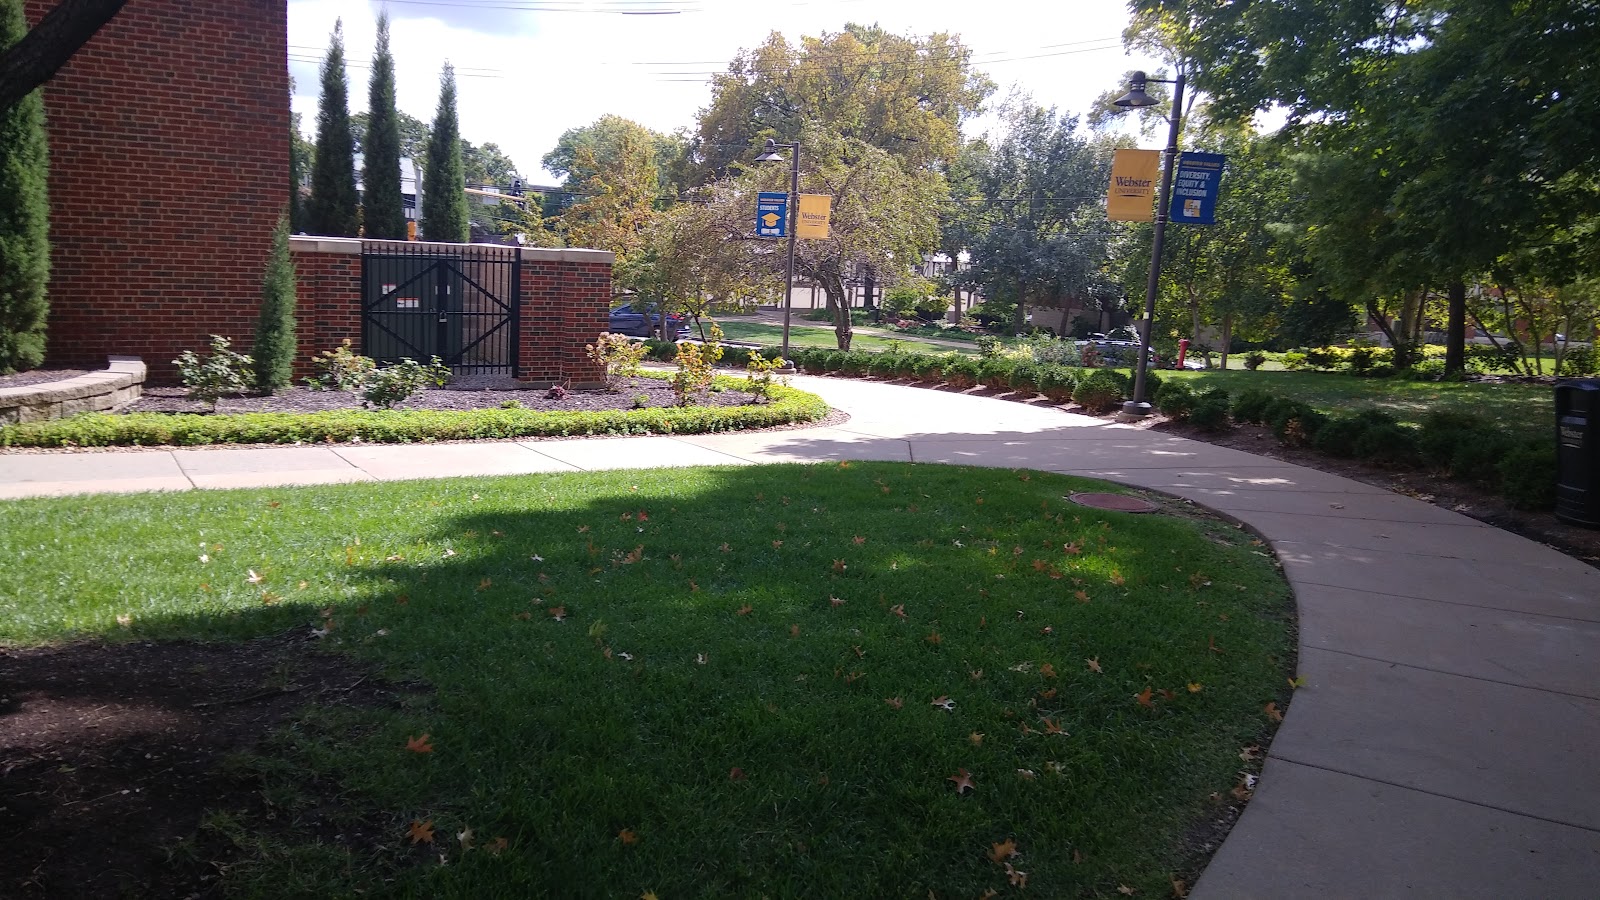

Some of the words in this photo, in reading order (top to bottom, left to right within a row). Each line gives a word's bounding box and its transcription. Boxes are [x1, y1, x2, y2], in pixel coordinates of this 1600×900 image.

[1115, 176, 1152, 187] Webster
[1177, 180, 1199, 188] EQUITY
[1199, 181, 1206, 189] &
[1176, 188, 1207, 197] INCLUSION
[802, 212, 826, 220] Webster
[1560, 425, 1584, 439] Webster
